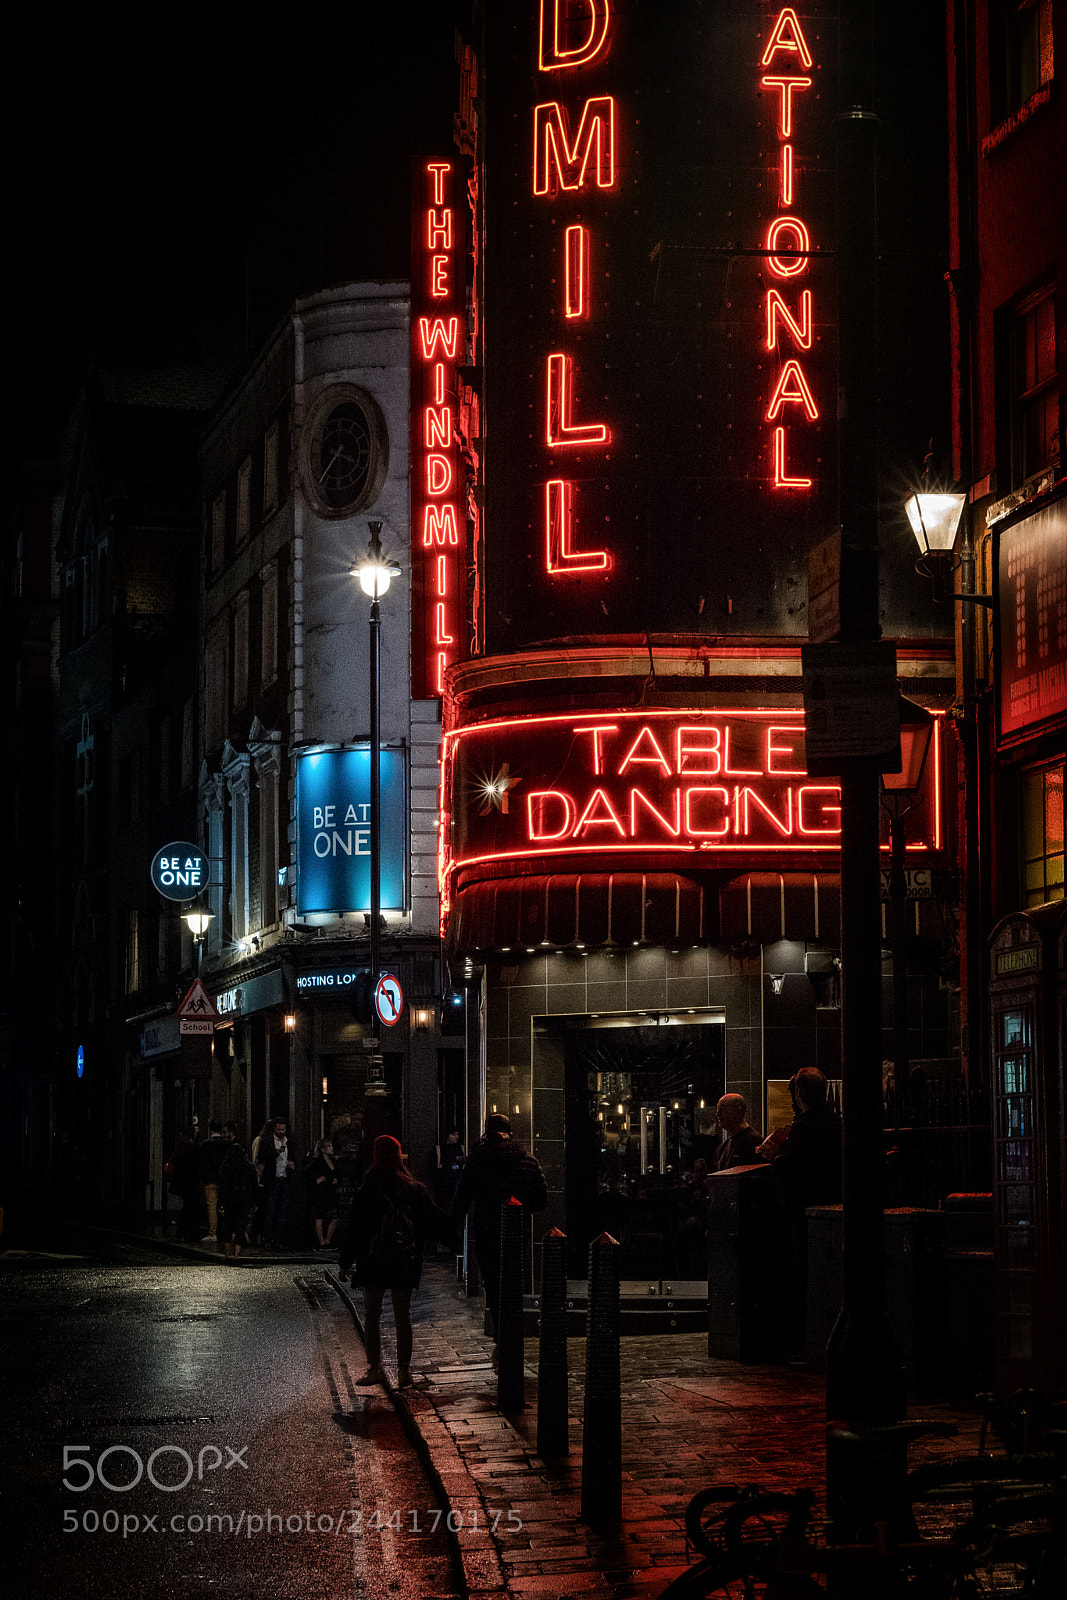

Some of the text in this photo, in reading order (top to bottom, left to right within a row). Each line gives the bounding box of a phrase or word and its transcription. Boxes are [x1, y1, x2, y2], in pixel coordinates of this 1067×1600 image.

[760, 8, 819, 488] ATIONAL
[418, 163, 459, 692] THE WINDMILL
[572, 726, 808, 776] TABLE
[313, 803, 372, 829] BE AT
[527, 786, 842, 840] DANCING
[313, 829, 372, 858] ONE
[160, 857, 202, 870] BE AT
[160, 871, 201, 886] ONE
[999, 949, 1037, 972] TELEPHONE
[297, 974, 335, 988] HOSTING
[182, 1023, 211, 1031] School
